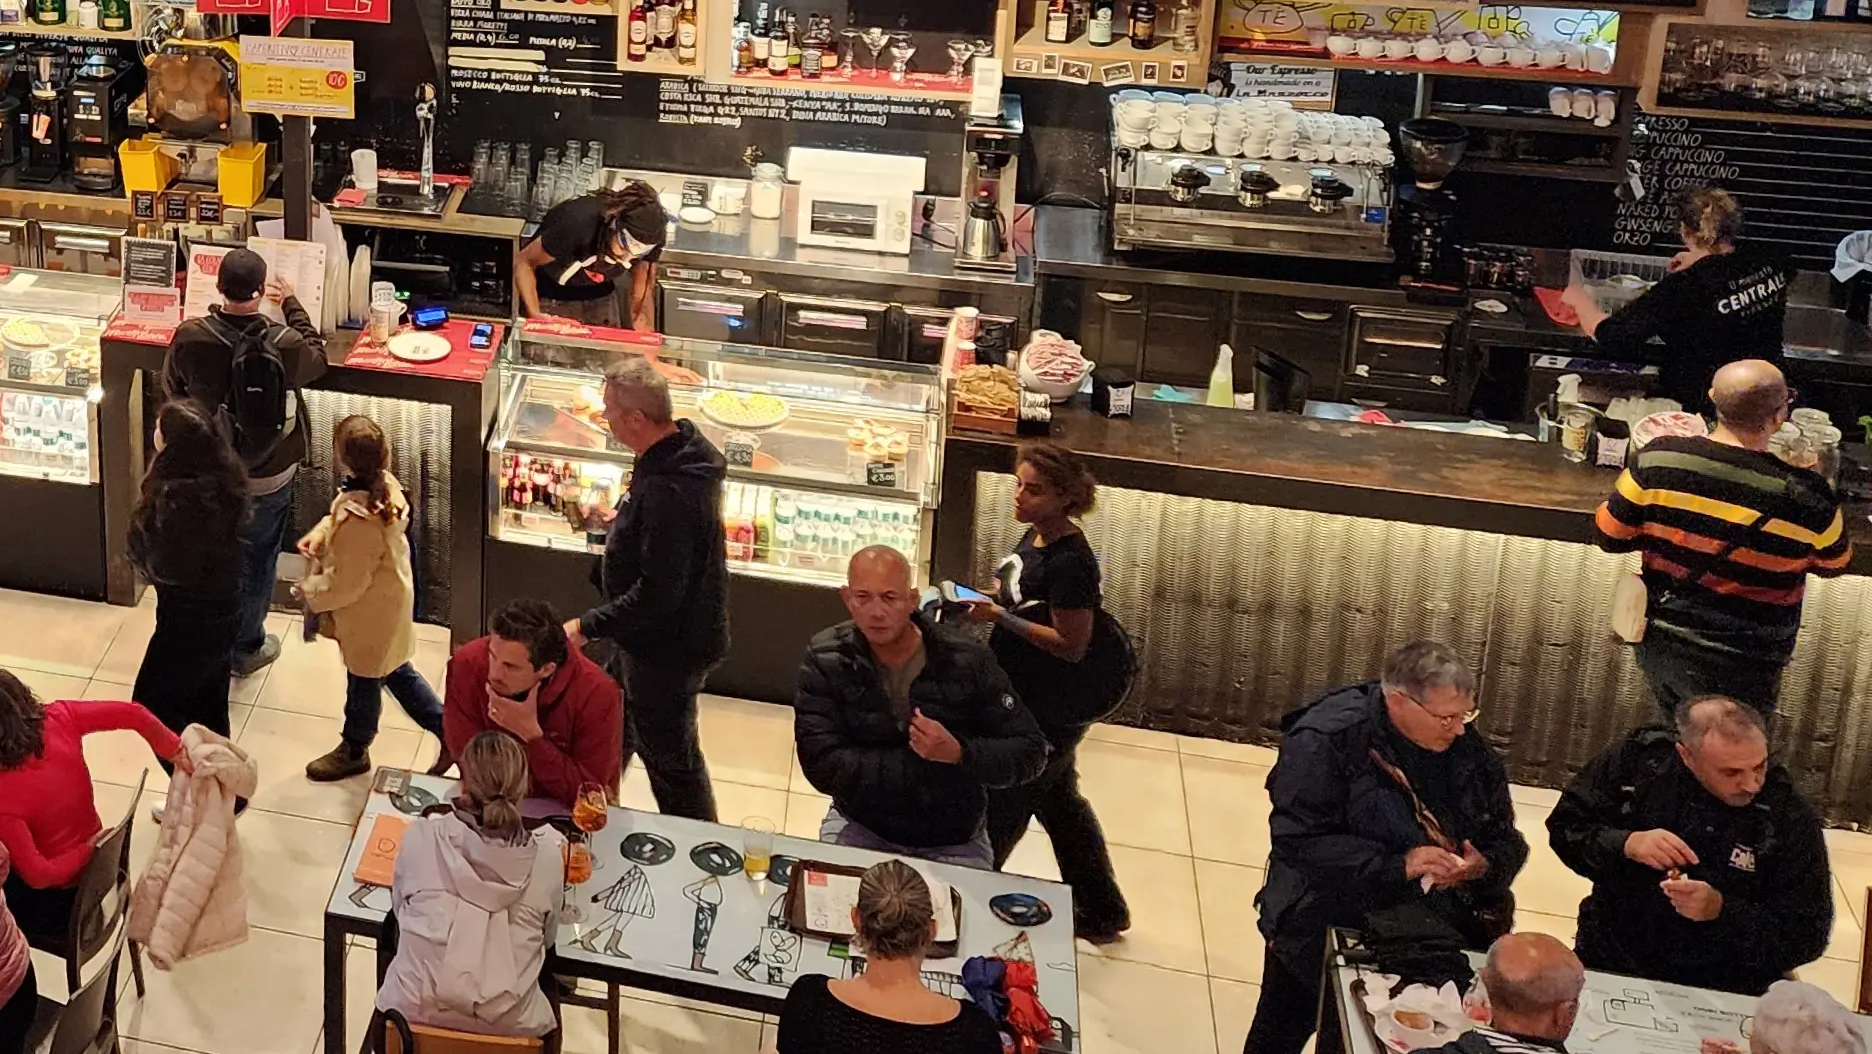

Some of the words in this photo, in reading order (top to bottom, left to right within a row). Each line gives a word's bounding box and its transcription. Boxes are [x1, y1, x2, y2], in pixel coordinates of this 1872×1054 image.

[1246, 64, 1266, 75] Our
[1270, 64, 1318, 77] Espresso
[1253, 77, 1301, 87] handmade
[1634, 115, 1689, 131] PRESSO
[1649, 130, 1702, 147] PUCCINO
[1650, 146, 1725, 164] CAPPUCCINO
[1665, 161, 1740, 180] CAPPUCCINO
[1616, 203, 1660, 218] NAKED
[1614, 216, 1675, 234] GINSENG
[1613, 231, 1651, 246] ORZO
